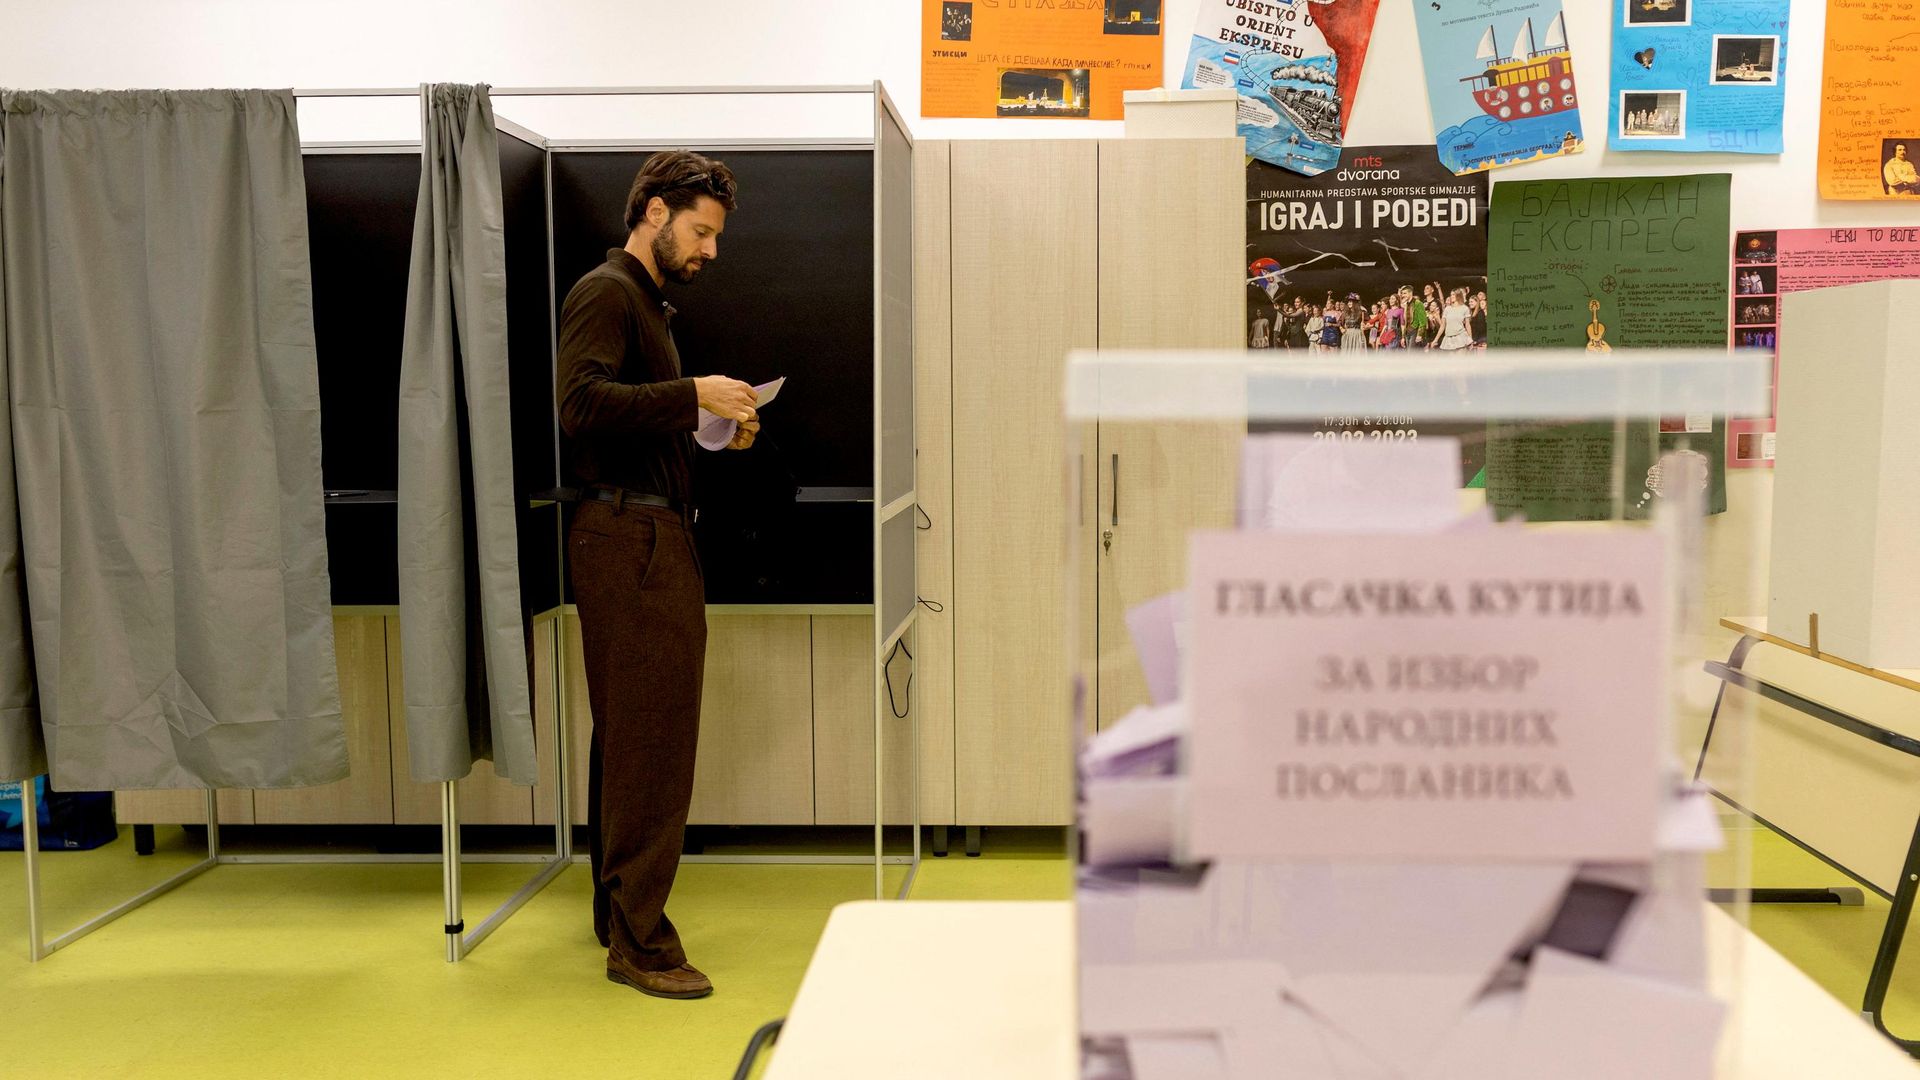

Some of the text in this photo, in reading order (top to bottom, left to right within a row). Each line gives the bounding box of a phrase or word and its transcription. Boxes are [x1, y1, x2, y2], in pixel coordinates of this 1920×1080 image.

[1236, 15, 1296, 39] ORIENT
[1304, 15, 1316, 27] U
[1219, 27, 1304, 59] EKSPRESU
[977, 54, 999, 63] ШТА
[1002, 55, 1011, 63] СЕ
[1013, 55, 1050, 65] ДЕШАВА
[1052, 57, 1073, 67] КАДА
[1337, 168, 1400, 181] dvorana
[1354, 155, 1382, 167] mts
[1261, 186, 1476, 198] HUMANITARNA PREDSTAVA SPORTSKE GIMNAZIJE
[1521, 181, 1700, 217] БАЛКАН
[1261, 198, 1476, 230] IGRAJ I POBEDI
[1511, 217, 1696, 253] ЕКСПРЕС
[1867, 229, 1883, 242] ТО
[1323, 415, 1413, 426] 17:30h & 20:00h
[1215, 579, 1643, 621] ГЛАСАЧКА КУТИЈА
[1316, 655, 1540, 691] ЗА ИЗБОР
[1296, 709, 1559, 748] НАРОДНИХ
[1275, 763, 1575, 799] ПОСЛАНИКА
